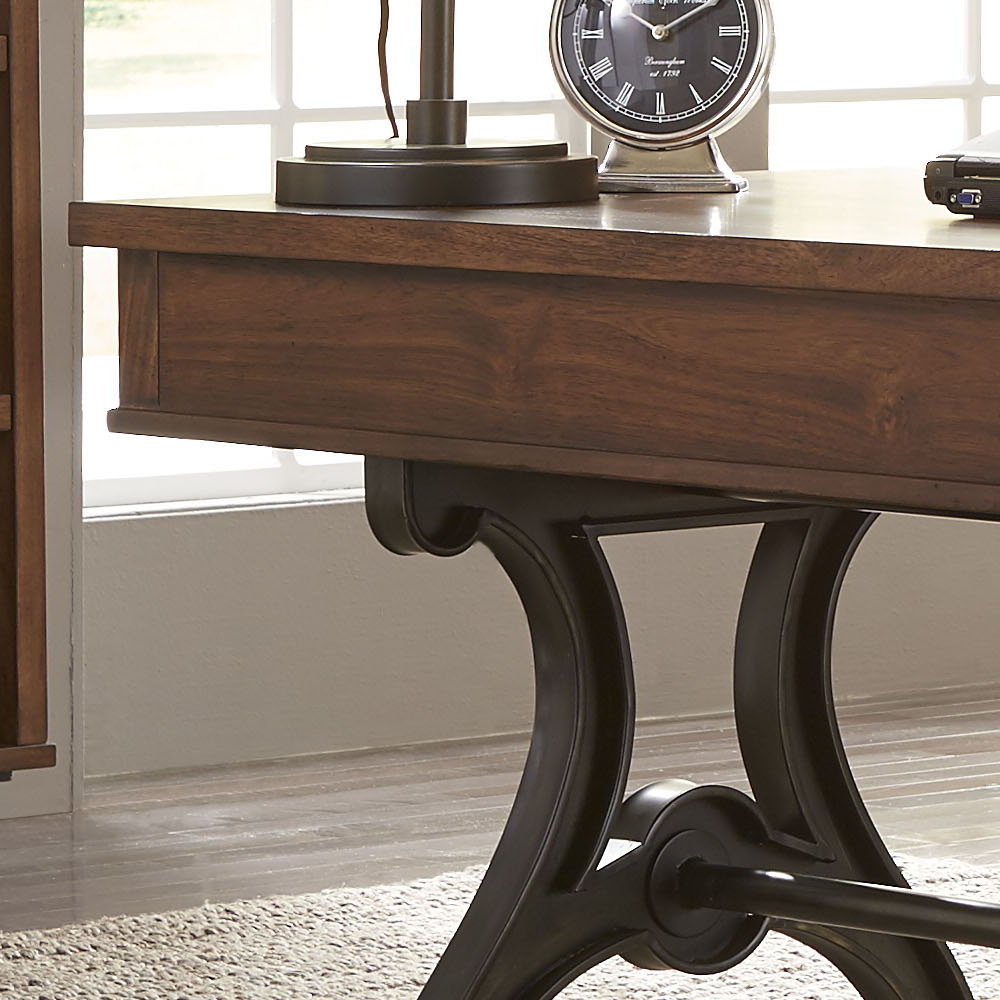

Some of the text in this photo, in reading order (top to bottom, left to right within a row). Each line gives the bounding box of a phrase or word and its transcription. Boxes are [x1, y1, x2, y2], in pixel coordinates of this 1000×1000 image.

[718, 25, 742, 37] III
[615, 81, 635, 107] VII
[655, 92, 666, 115] VI
